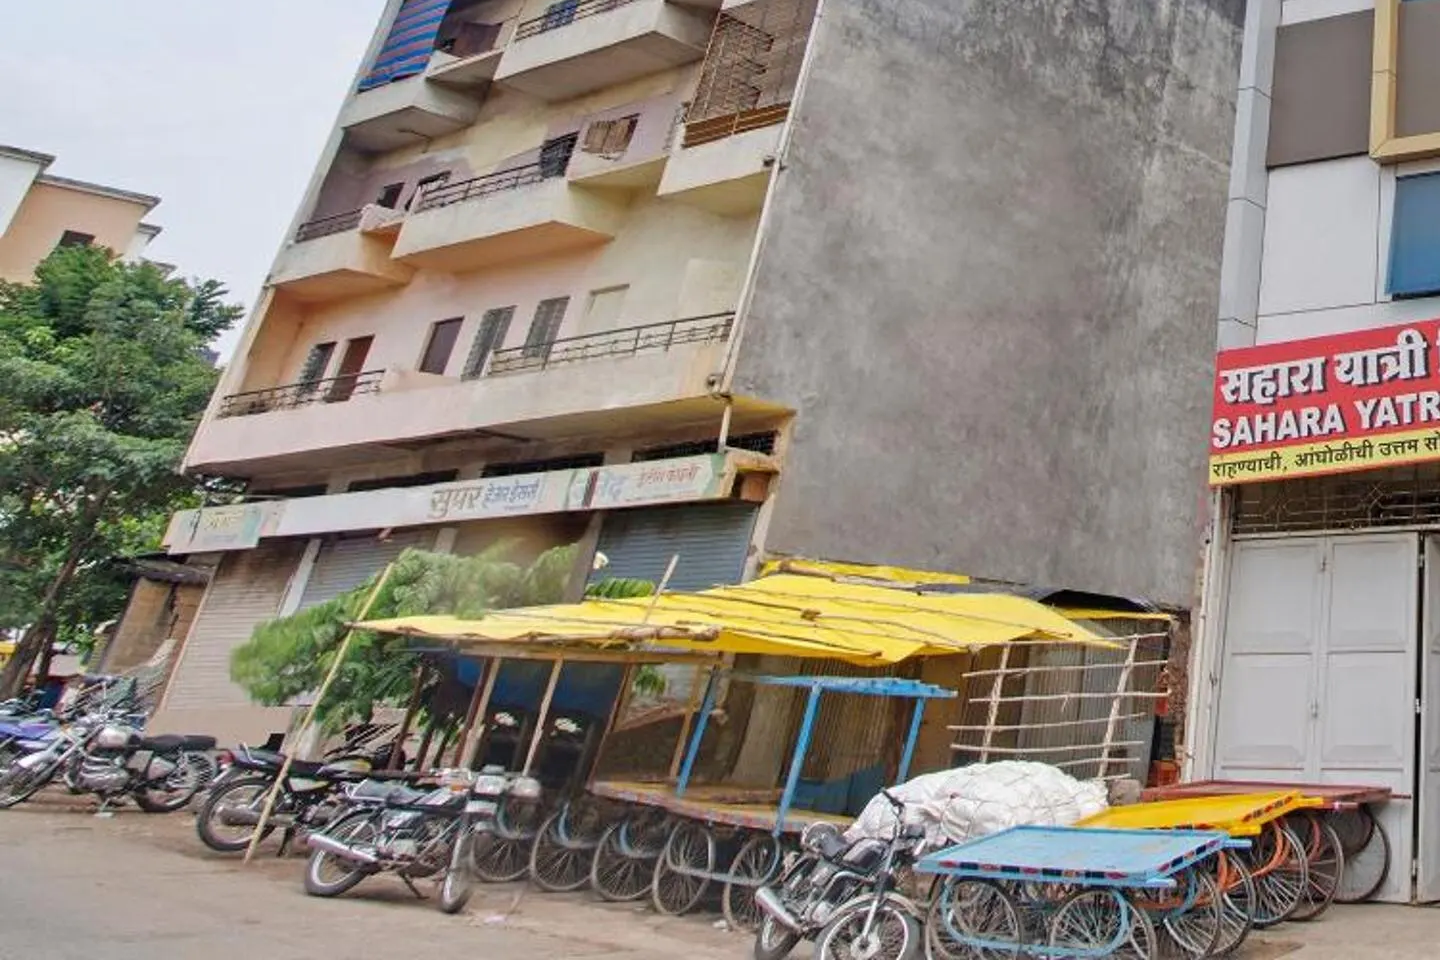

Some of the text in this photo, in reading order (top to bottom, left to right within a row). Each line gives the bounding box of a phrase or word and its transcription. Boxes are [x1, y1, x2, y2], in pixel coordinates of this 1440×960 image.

[1220, 357, 1329, 405] सहारा
[1334, 328, 1429, 387] यात्री
[1213, 404, 1345, 448] SAHARA
[1379, 437, 1419, 457] उत्तम
